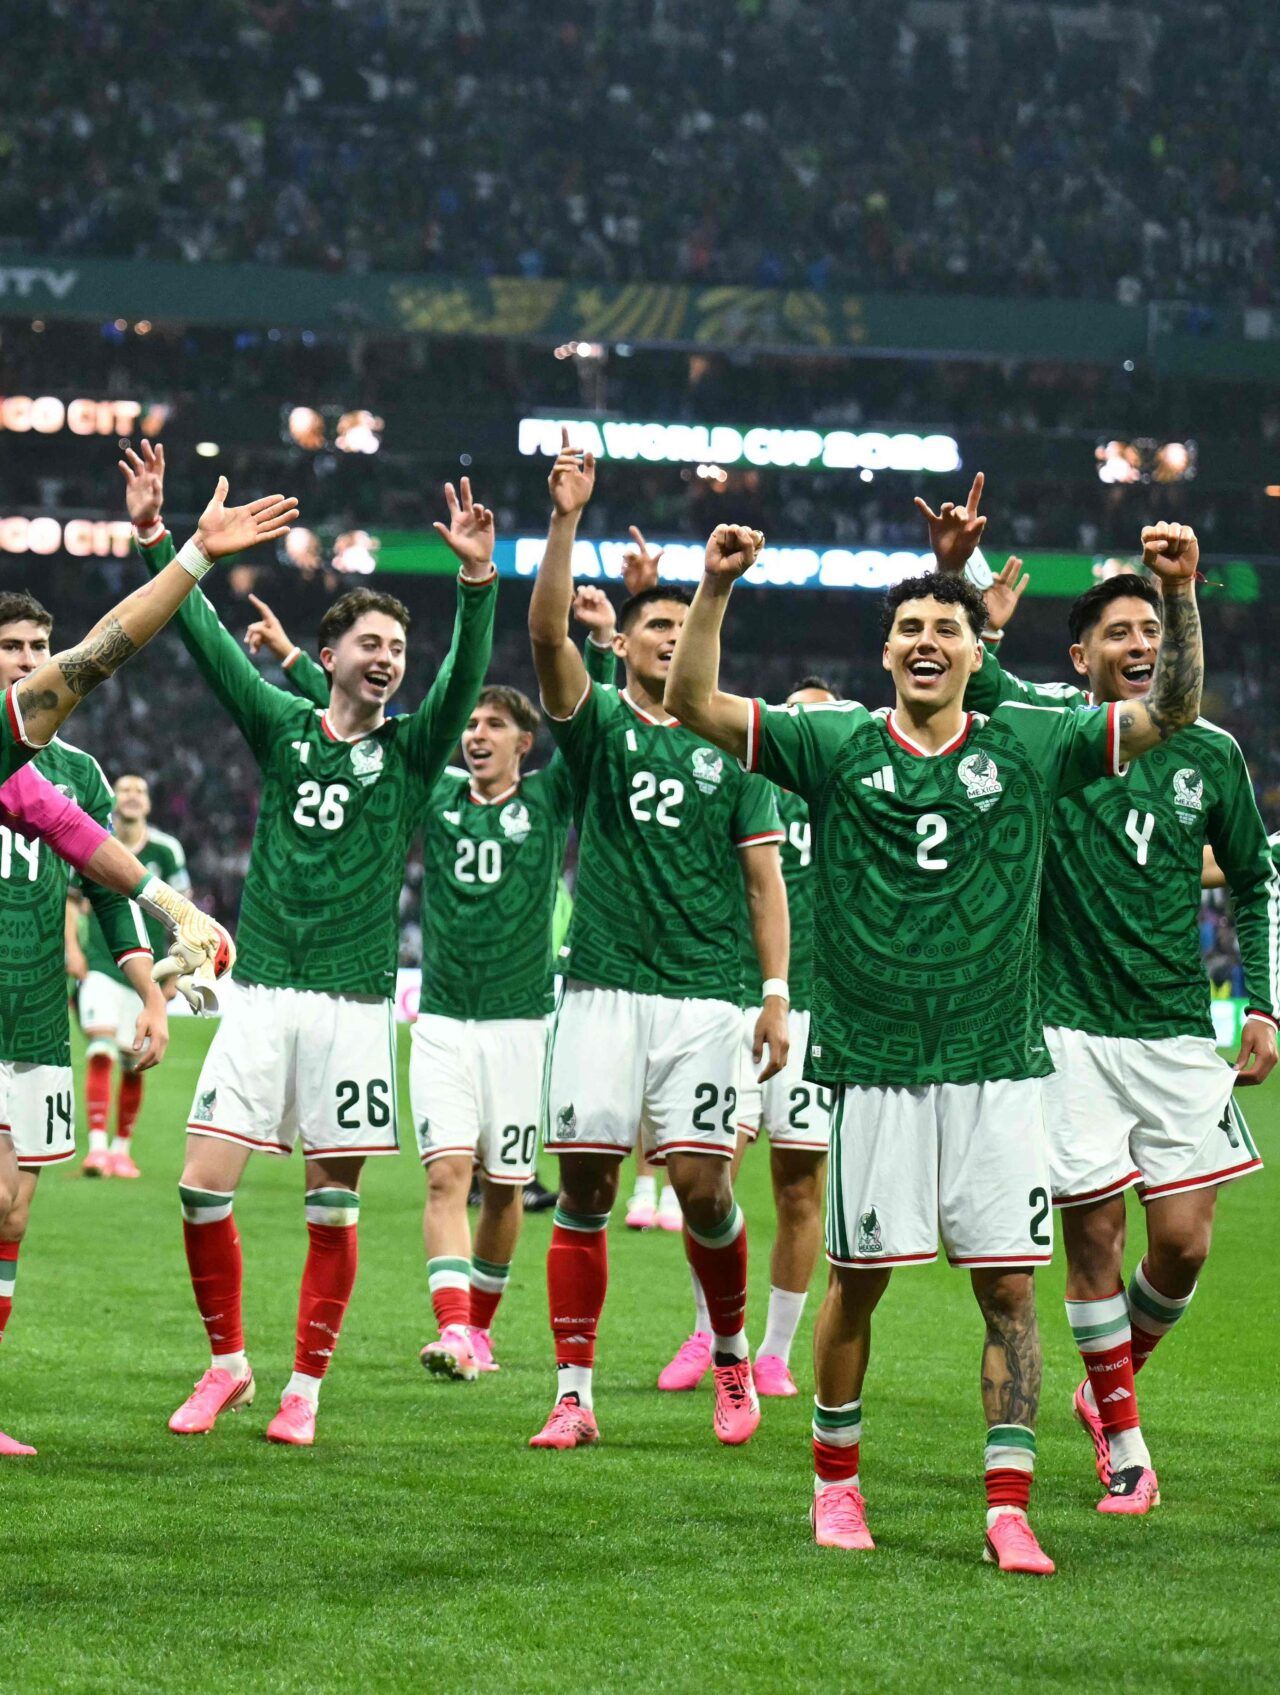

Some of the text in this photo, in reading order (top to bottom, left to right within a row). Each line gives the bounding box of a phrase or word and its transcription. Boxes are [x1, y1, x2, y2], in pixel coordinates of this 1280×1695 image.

[743, 426, 823, 467] CUP
[293, 780, 350, 831] 26
[628, 771, 685, 828] 22
[455, 838, 502, 884] 20
[779, 821, 812, 867] 4
[916, 813, 948, 871] 2
[1124, 808, 1156, 866] 4
[45, 1090, 71, 1145] 14
[335, 1078, 390, 1129] 26
[692, 1082, 737, 1135] 22
[501, 1124, 537, 1165] 20
[1029, 1186, 1050, 1246] 2
